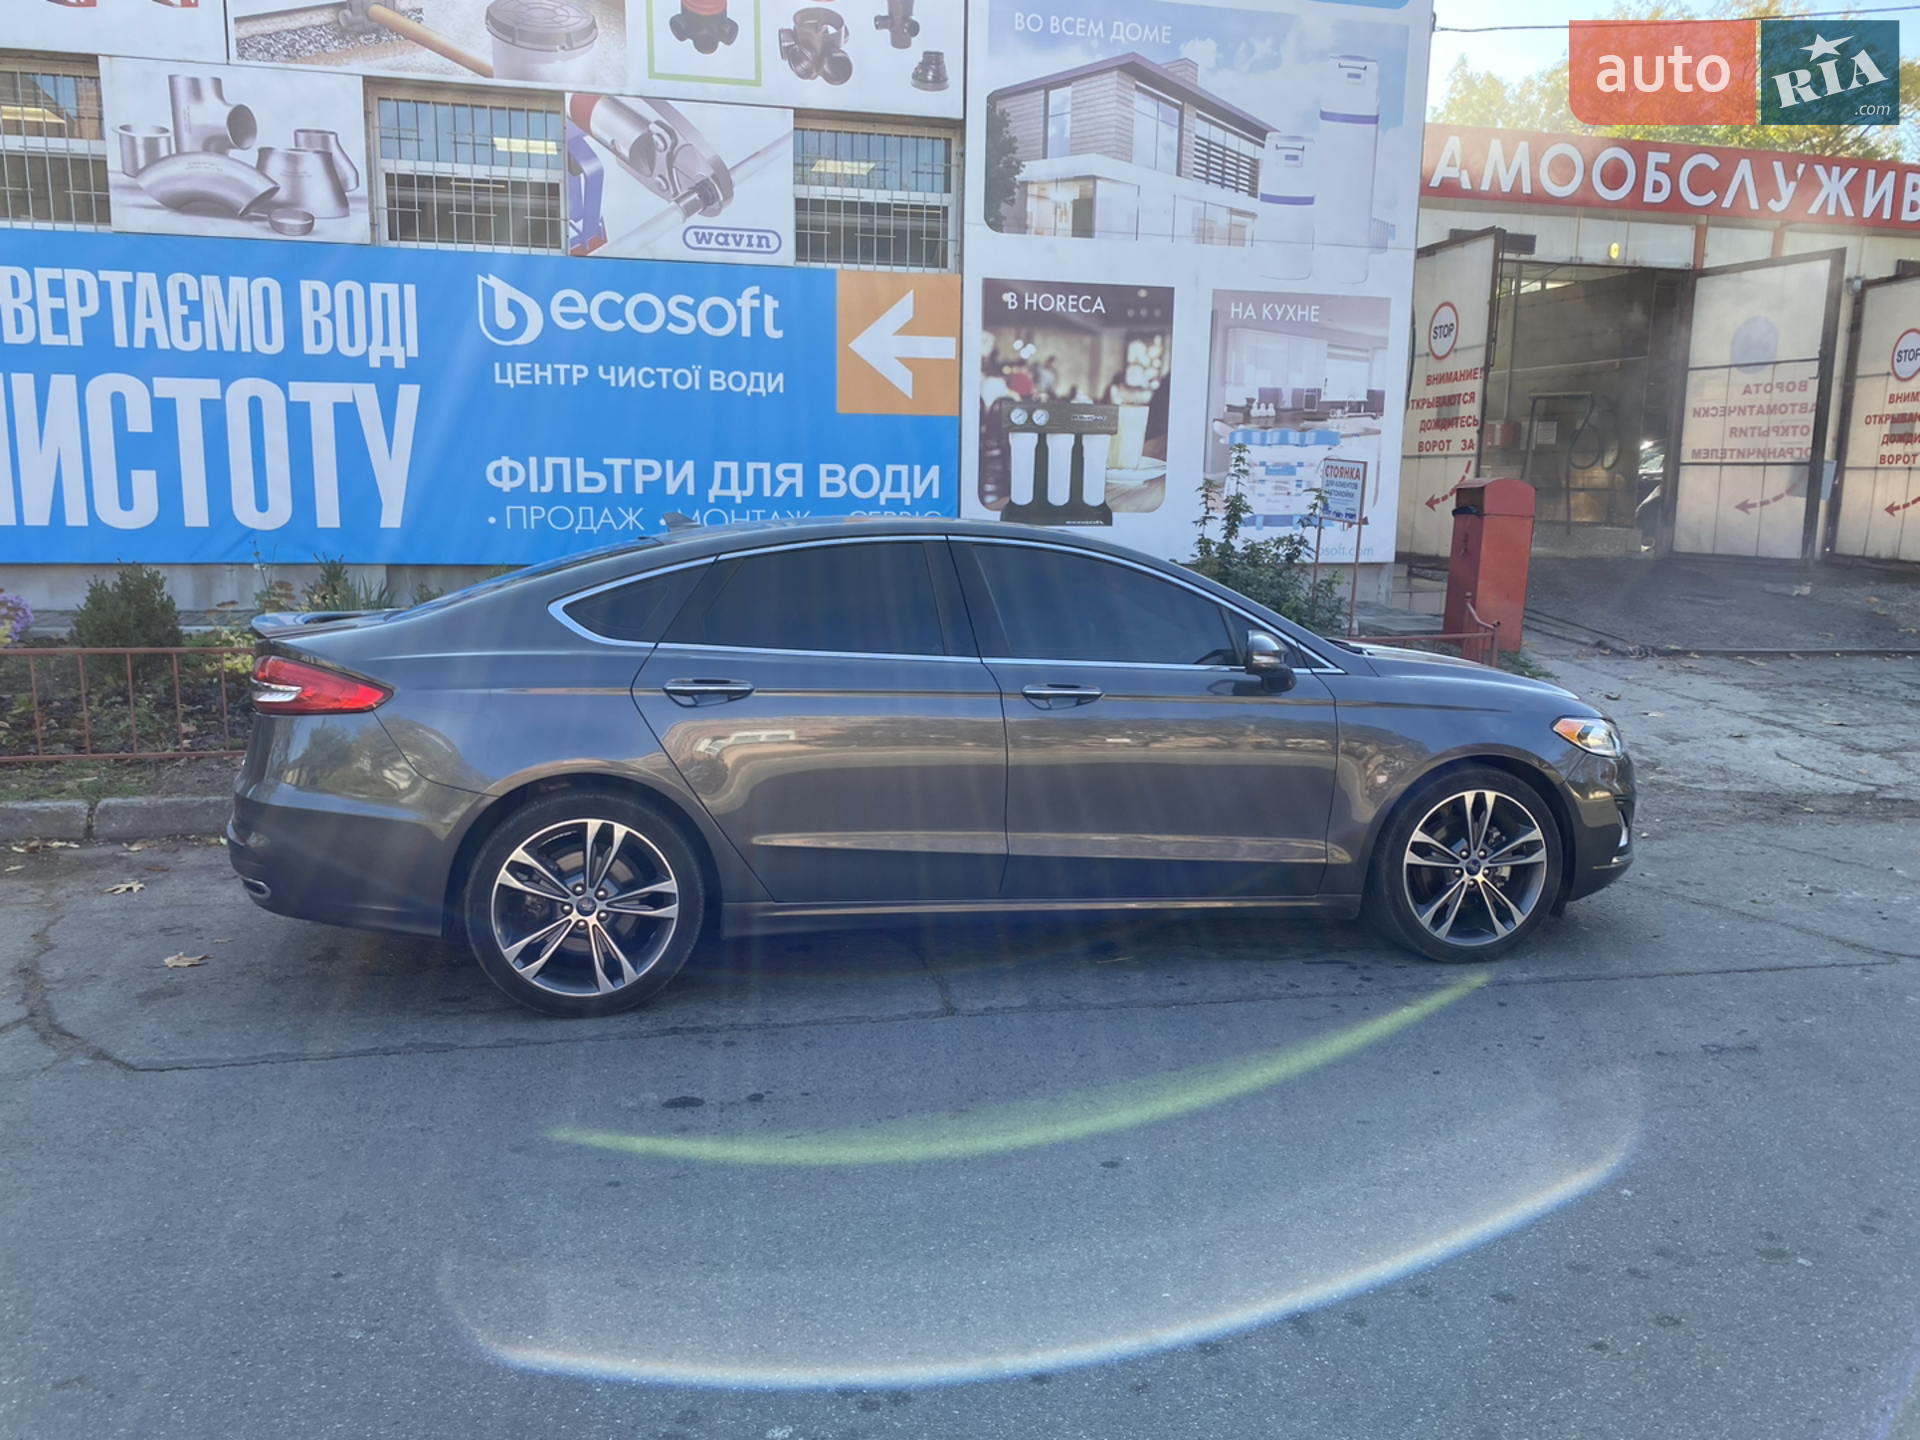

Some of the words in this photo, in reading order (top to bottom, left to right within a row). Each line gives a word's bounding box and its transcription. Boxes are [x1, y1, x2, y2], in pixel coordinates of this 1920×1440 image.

[1015, 12, 1043, 32] ВО
[1050, 15, 1104, 38] ВСЕМ
[1110, 21, 1172, 44] ДОМЕ
[693, 230, 772, 249] wavin
[550, 286, 783, 339] ecosoft
[1025, 293, 1106, 314] HORECA
[1230, 302, 1256, 320] НА
[1262, 304, 1319, 322] КУХНЕ
[300, 279, 419, 368] ВОДІ
[1432, 323, 1455, 340] STOP
[494, 362, 589, 388] ЦЕНТР
[598, 364, 702, 390] ЧИСТОЇ
[709, 370, 784, 397] ВОДИ
[1426, 367, 1483, 386] ВНИМАНИЕ!
[1888, 391, 1920, 404] ВНИМ
[1419, 415, 1479, 433] ДОЖДИТЕСЬ
[0, 372, 421, 531] ИСТОТУ
[1418, 439, 1452, 452] ВОРОТ
[1460, 438, 1475, 451] ЗА
[1879, 454, 1918, 465] ВОРОТ
[485, 456, 695, 495] ФІЛЬТРИ
[708, 461, 803, 504] ДЛЯ
[819, 463, 940, 505] ВОДИ
[1325, 465, 1360, 480] СТОЯНКА
[506, 505, 645, 534] ПРОДАЖ
